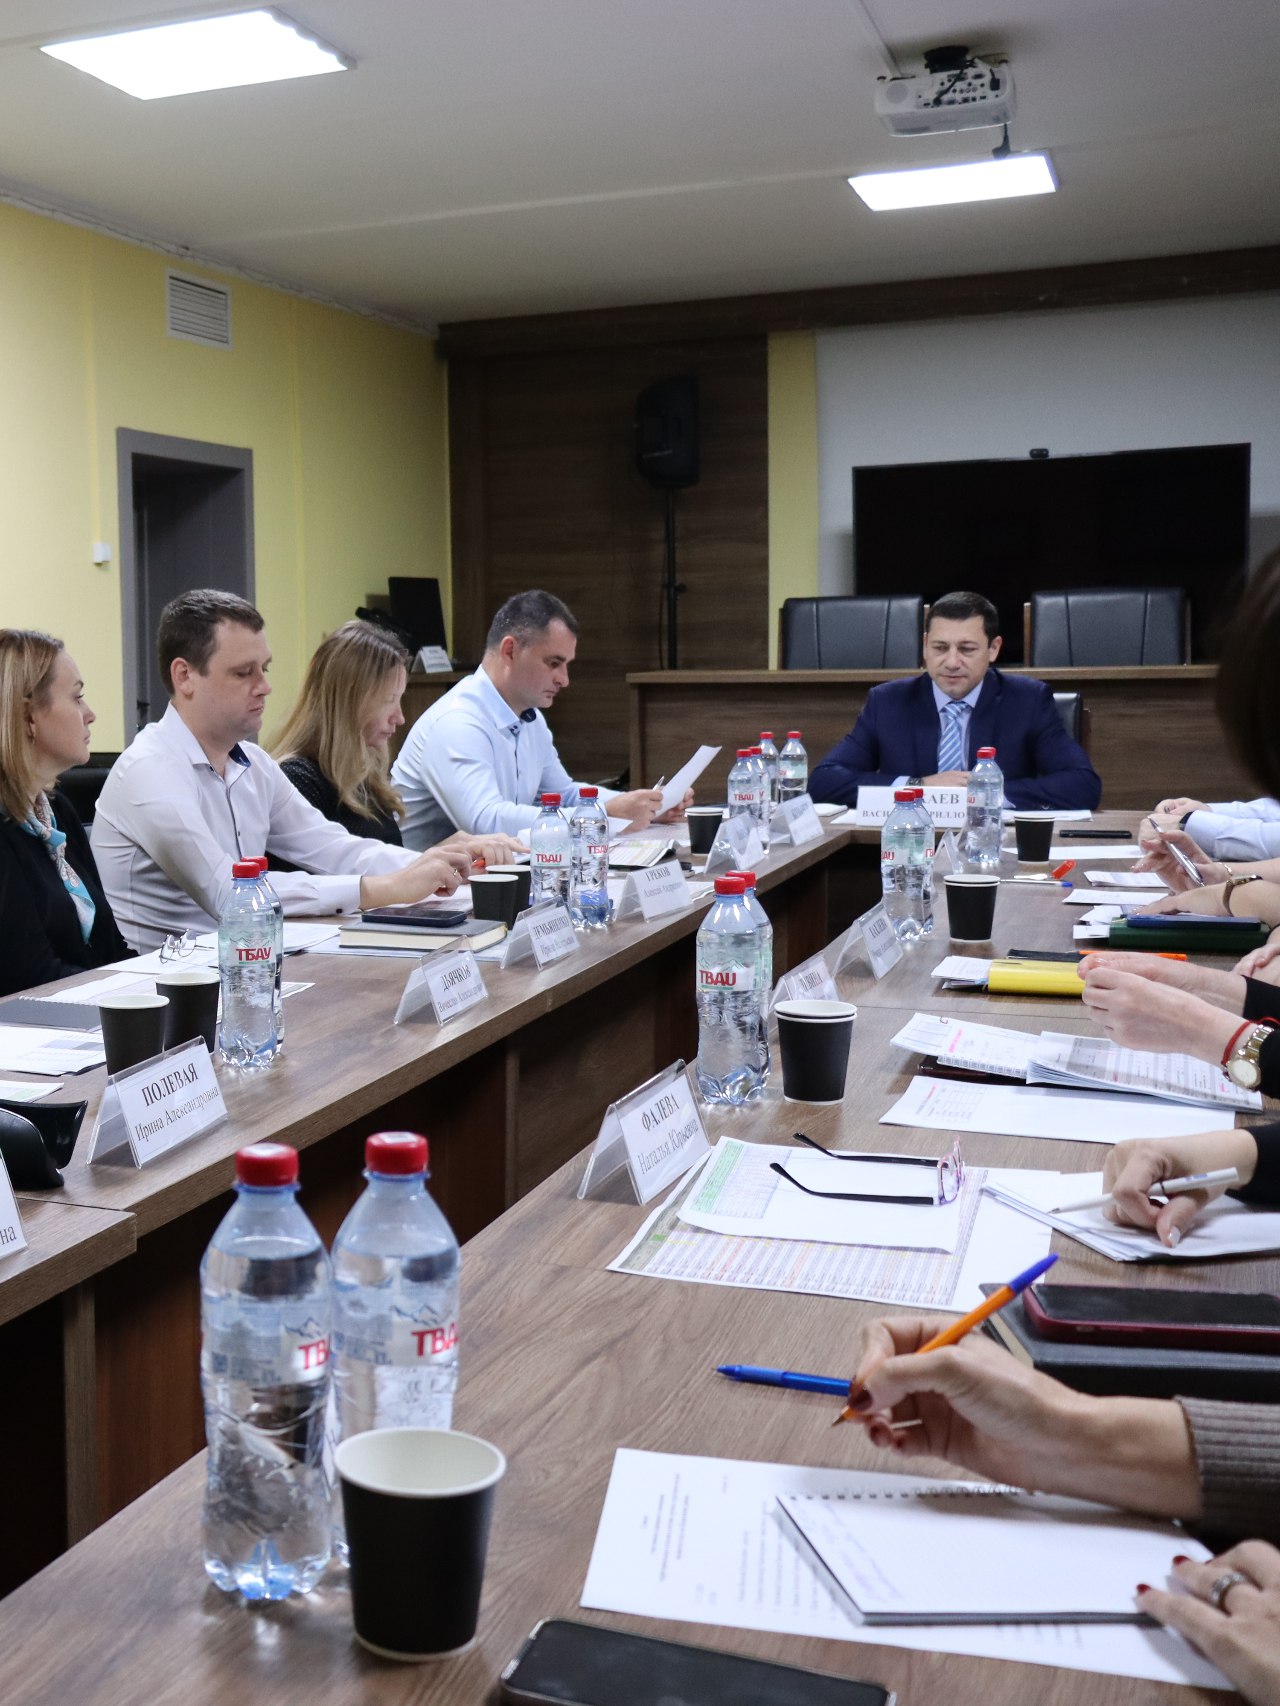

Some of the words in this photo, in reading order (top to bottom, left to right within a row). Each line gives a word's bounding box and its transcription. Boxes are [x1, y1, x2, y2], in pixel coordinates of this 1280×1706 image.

[236, 946, 272, 962] ТБАУ
[699, 969, 737, 987] TBAU
[141, 1062, 199, 1107] ПОЛЕВАЯ
[134, 1117, 165, 1142] Ирина
[165, 1085, 220, 1127] Александровна
[641, 1093, 680, 1132] ФАЛЕВА
[637, 1142, 671, 1175] Наталья
[667, 1119, 699, 1152] Юрьевна
